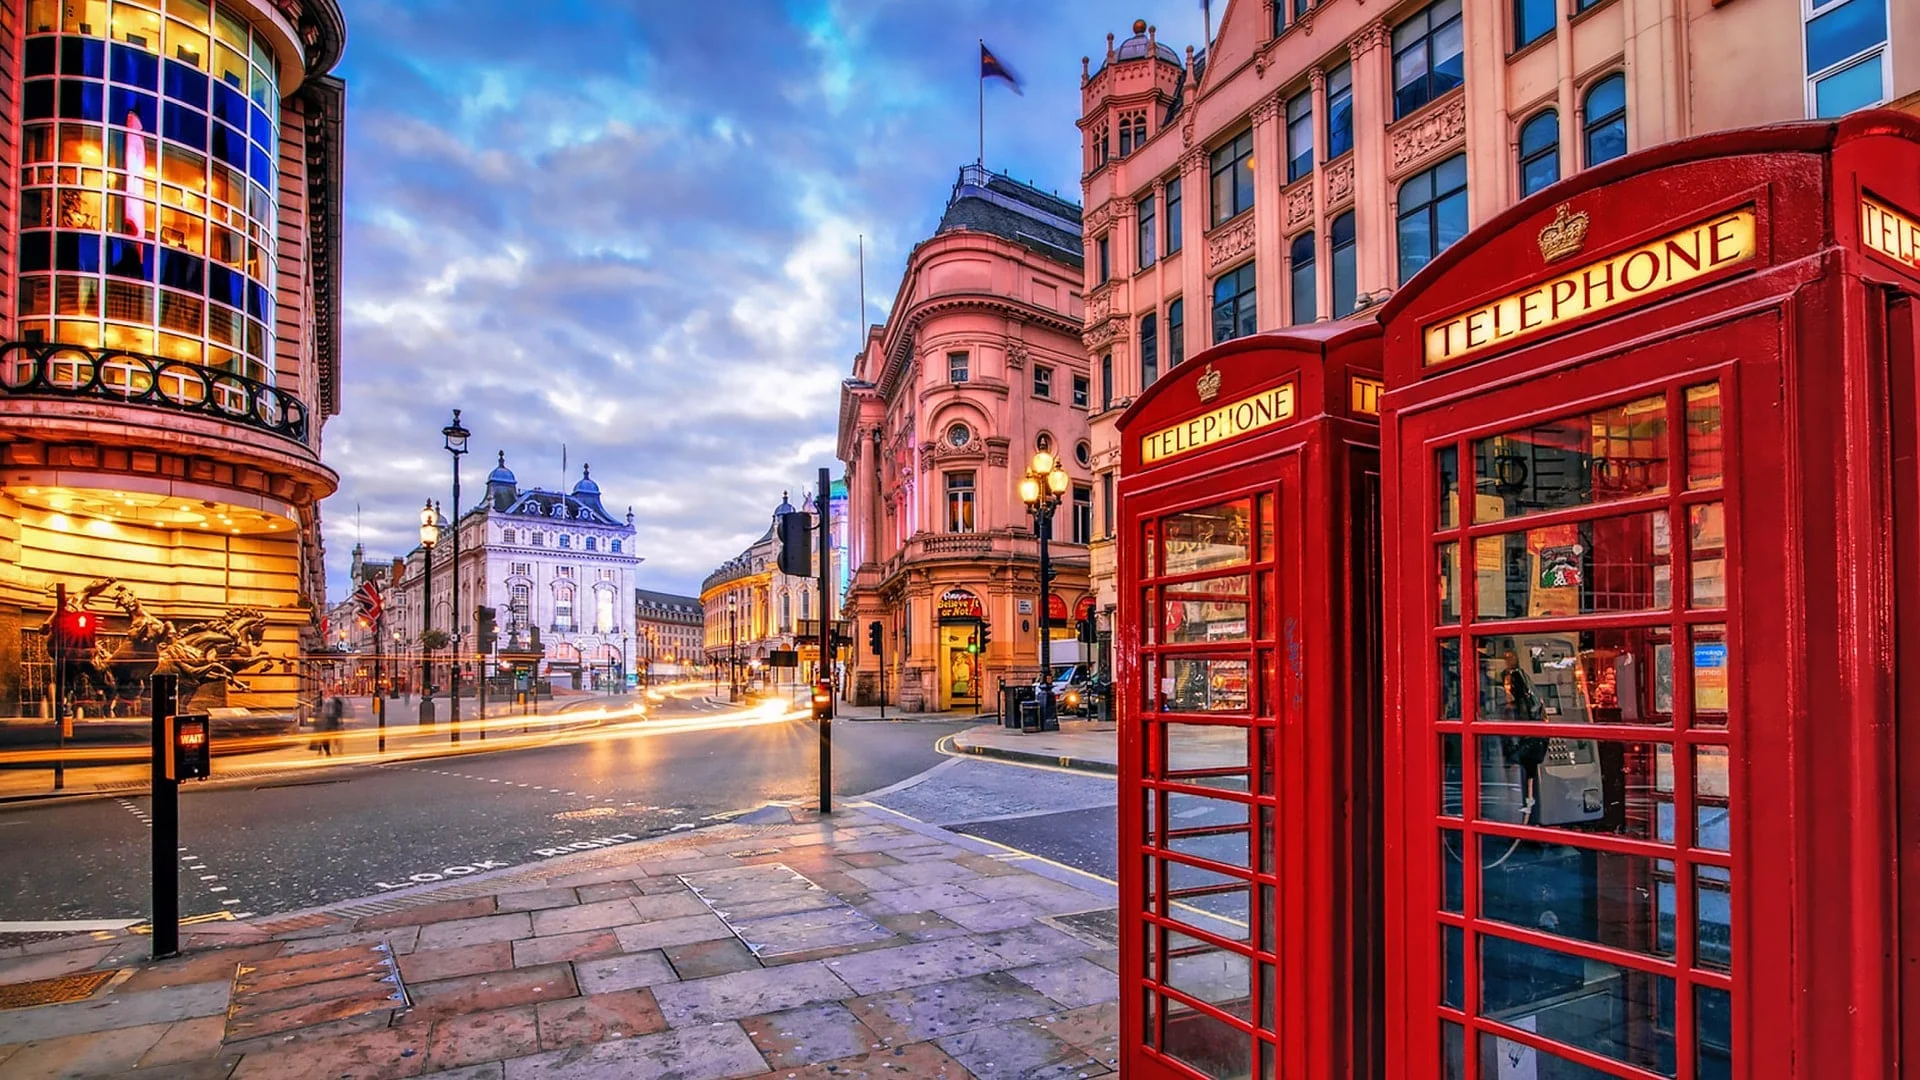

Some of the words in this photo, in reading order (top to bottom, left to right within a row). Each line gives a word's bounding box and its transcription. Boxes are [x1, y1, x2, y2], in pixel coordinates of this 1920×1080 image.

[1432, 216, 1740, 356] TELEPHONE
[1147, 388, 1289, 459] TELEPHONE
[937, 600, 968, 608] Believe
[181, 734, 203, 744] WAIT
[376, 859, 509, 889] LOOK
[533, 833, 638, 857] RIGHT
